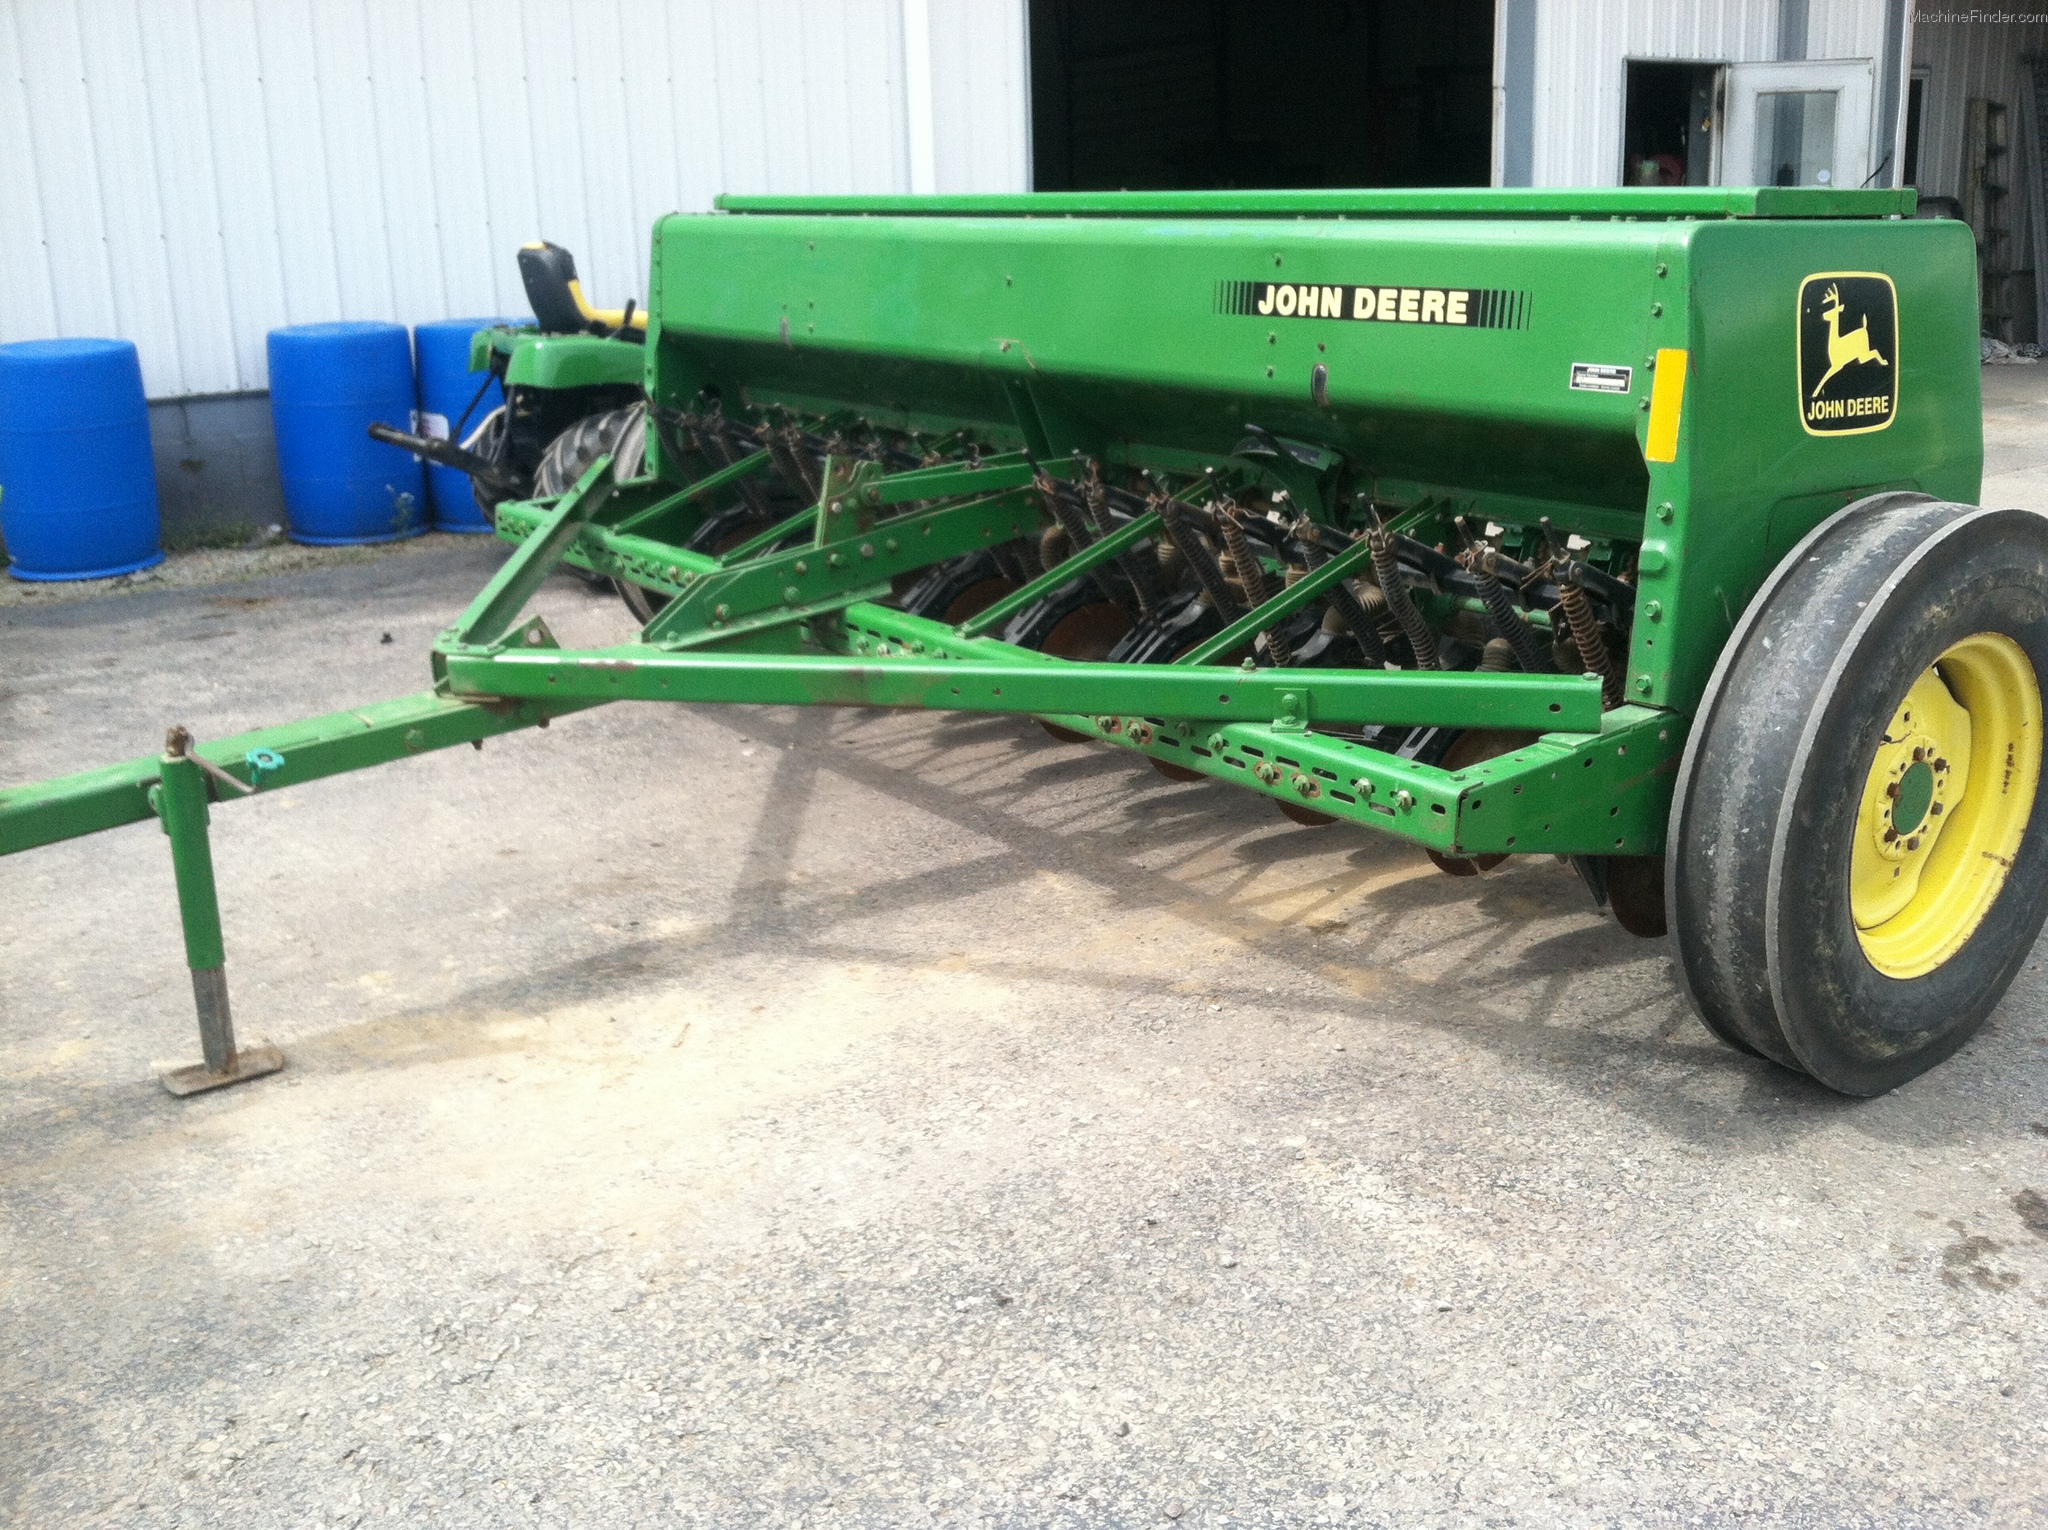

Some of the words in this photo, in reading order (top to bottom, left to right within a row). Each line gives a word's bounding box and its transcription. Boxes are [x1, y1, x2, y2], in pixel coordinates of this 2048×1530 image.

[1258, 284, 1342, 318] JOHN
[1353, 287, 1469, 324] DEERE
[1807, 399, 1844, 421] JOHN
[1847, 395, 1889, 417] DEERE
